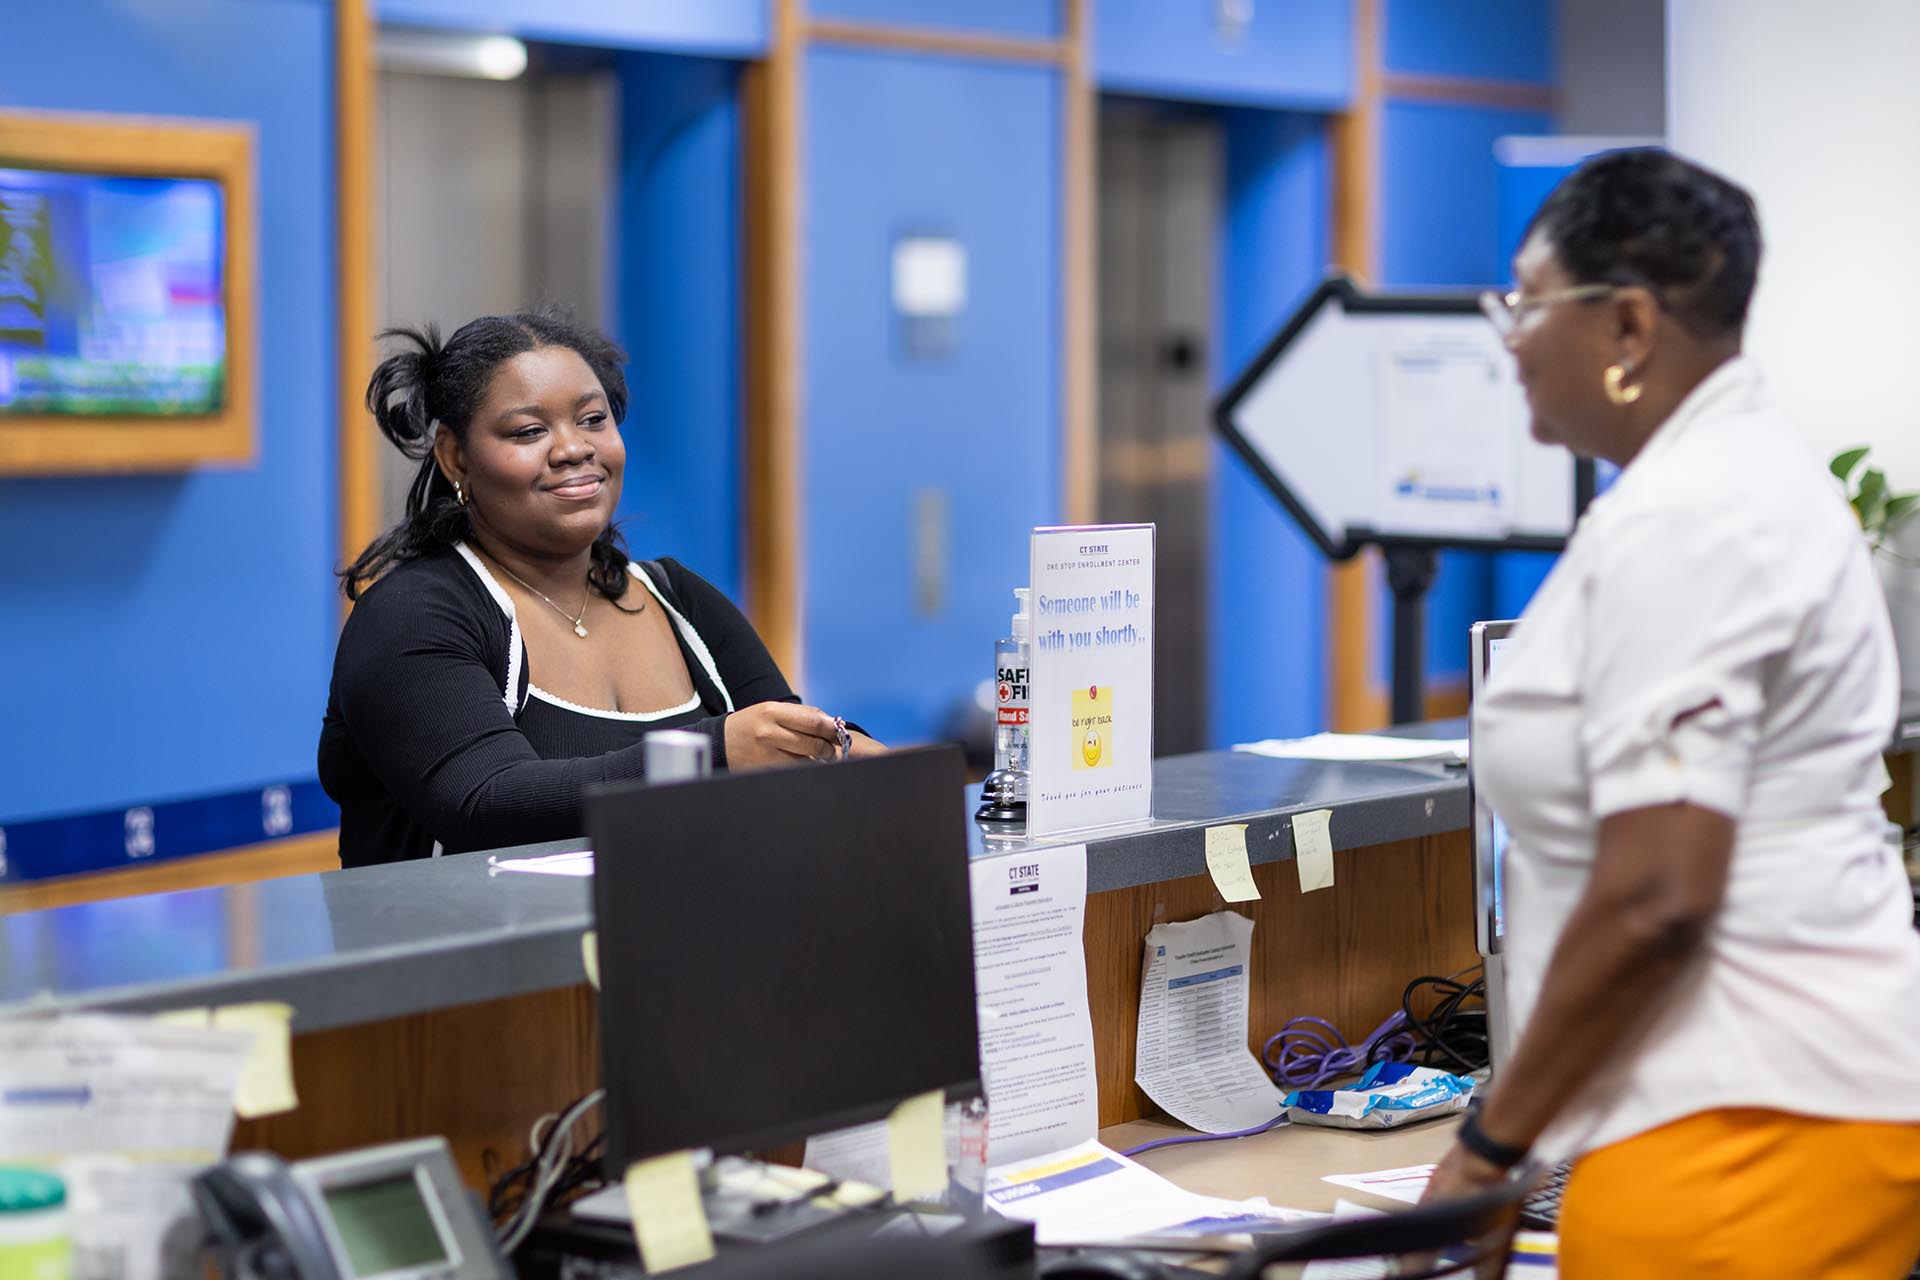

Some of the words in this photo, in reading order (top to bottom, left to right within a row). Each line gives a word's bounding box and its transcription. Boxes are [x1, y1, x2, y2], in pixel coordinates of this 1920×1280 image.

[1089, 545, 1109, 553] STATE
[1046, 563, 1058, 571] ONE
[1060, 562, 1076, 570] STOP
[1077, 560, 1116, 569] ENROLLMENT
[1117, 558, 1141, 567] CENTER
[1039, 594, 1097, 616] Someone
[1100, 590, 1121, 611] will
[1125, 589, 1140, 609] be
[1038, 629, 1065, 651] with
[1068, 631, 1092, 653] you
[998, 668, 1029, 684] SAF
[1071, 718, 1080, 728] be
[1097, 714, 1113, 725] back
[1040, 792, 1062, 801] Thank
[1065, 792, 1077, 800] you
[1095, 787, 1111, 797] your
[1008, 867, 1018, 880] CT
[1018, 863, 1040, 878] STATE
